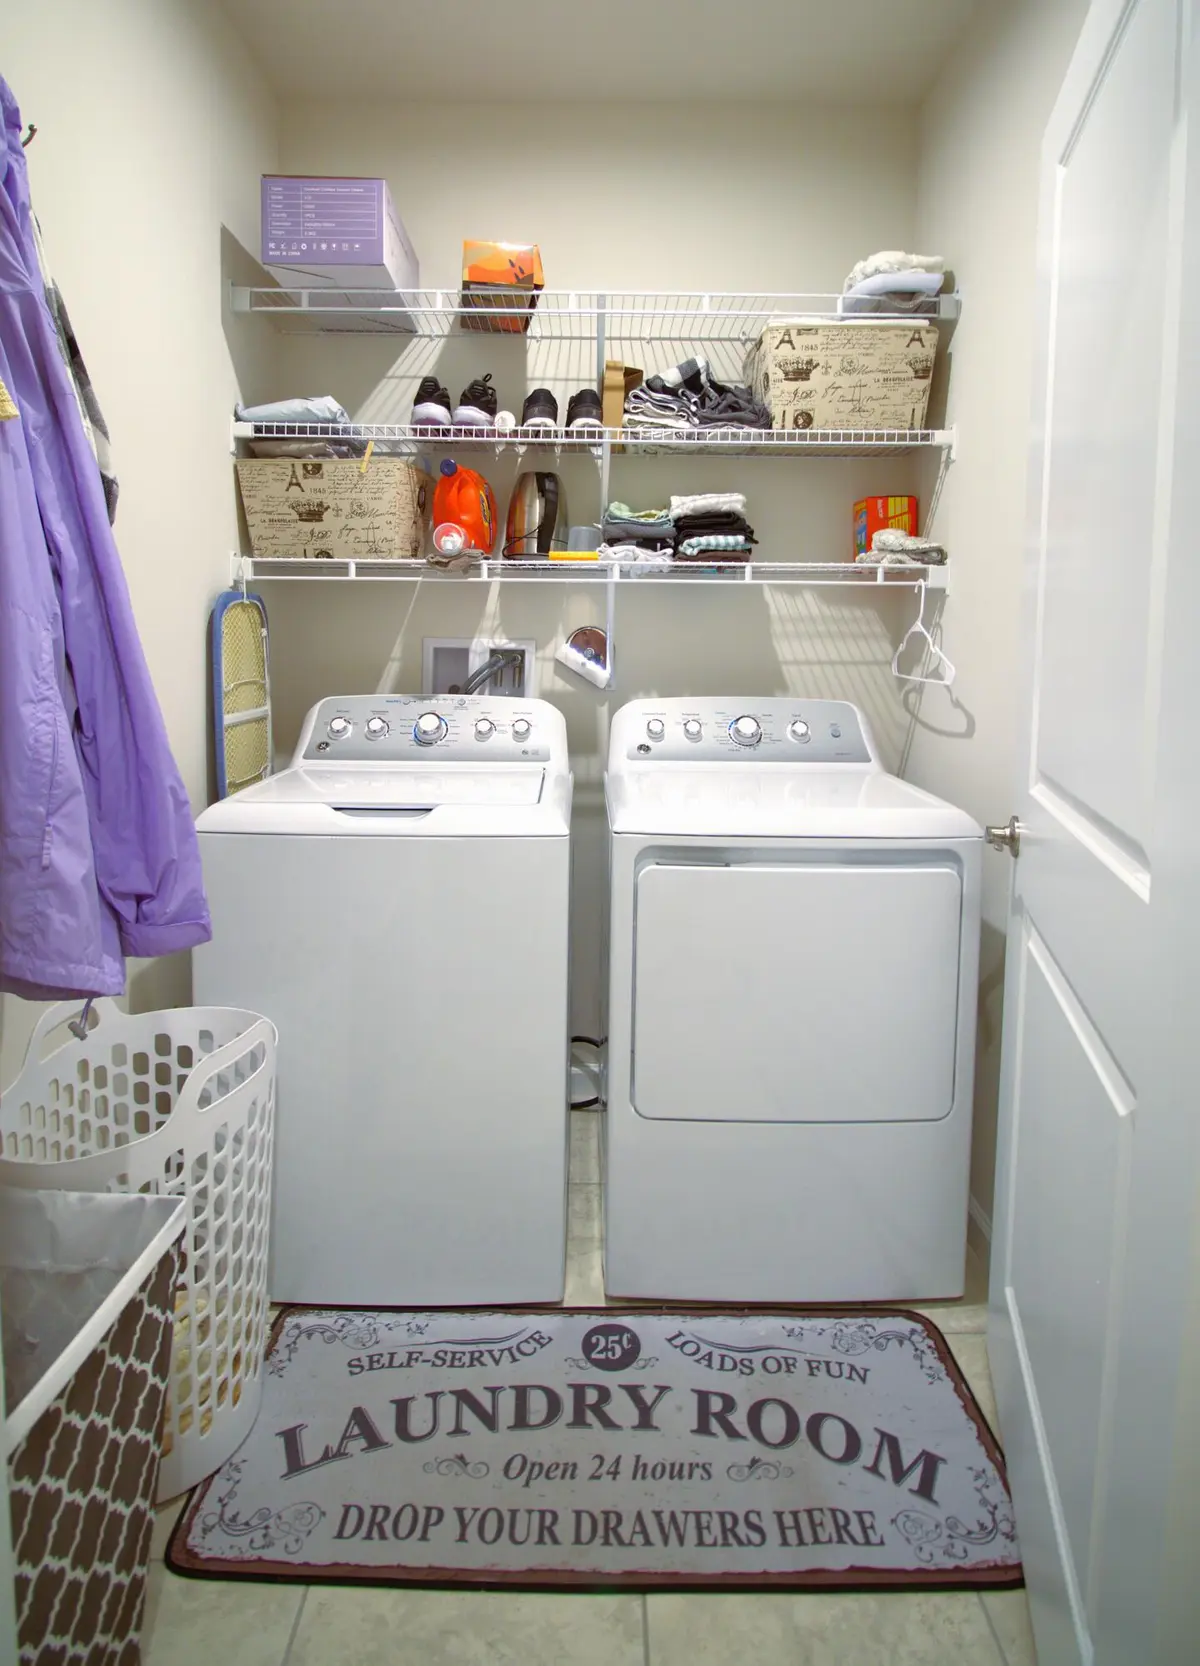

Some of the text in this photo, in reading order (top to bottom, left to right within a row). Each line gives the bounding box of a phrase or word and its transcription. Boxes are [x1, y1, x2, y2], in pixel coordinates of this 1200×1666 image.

[346, 1330, 553, 1376] SELF-SERVICE
[665, 1330, 870, 1385] LOADS OF FUN
[275, 1383, 948, 1506] LAUNDRY ROOM
[503, 1453, 713, 1488] Open 24 hours
[333, 1503, 885, 1548] DROP YOUR DRAWERS HERE
